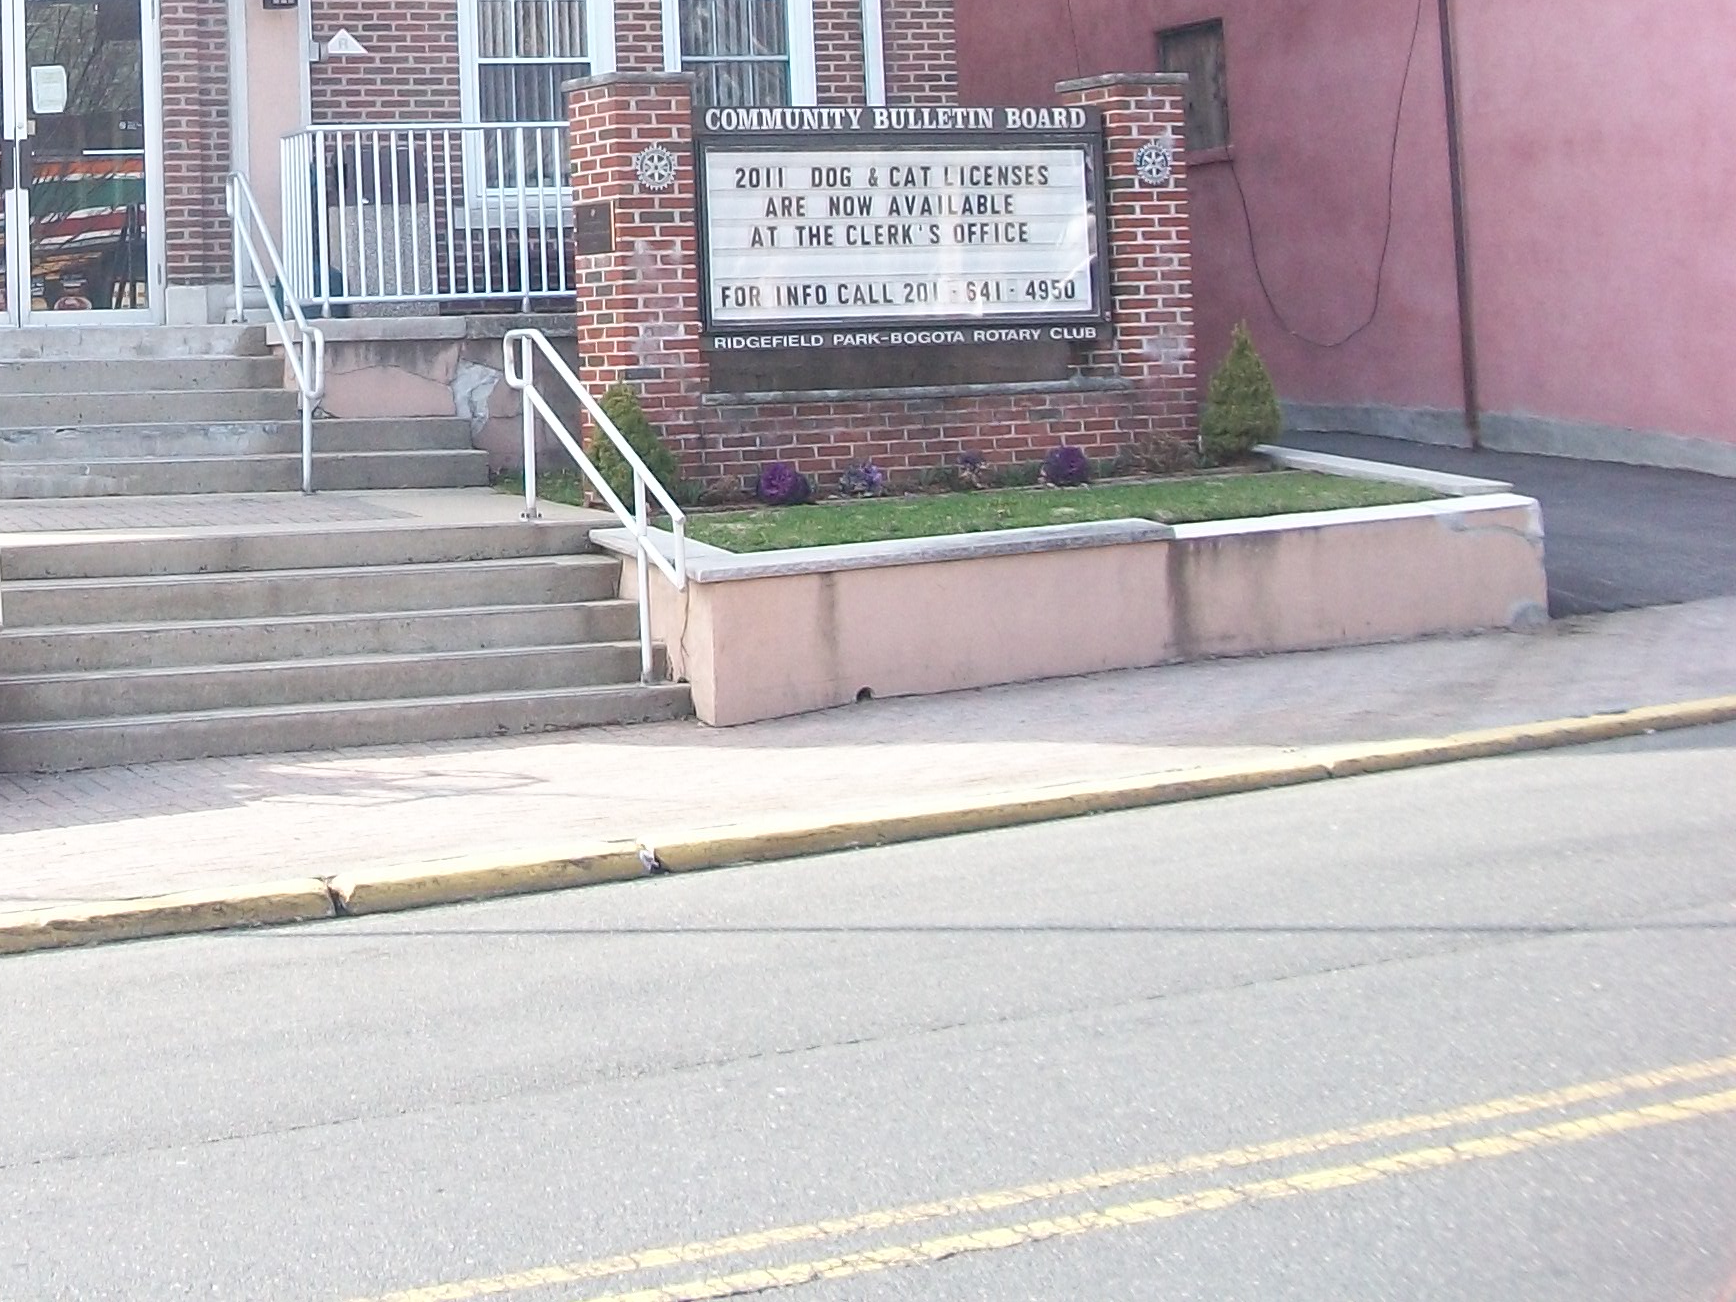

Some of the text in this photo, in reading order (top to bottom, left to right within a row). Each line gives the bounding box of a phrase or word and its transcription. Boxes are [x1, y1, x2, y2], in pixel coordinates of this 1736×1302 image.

[705, 107, 1087, 131] COMMUNITY BULLETIN BOARD
[735, 165, 1050, 189] 2011 DOG & CAT LICENSES
[765, 194, 1015, 218] ARE NOW AVAILABLE
[750, 222, 1030, 247] AT THE CLERK'S OFFICE
[720, 286, 762, 308] FOR
[776, 284, 828, 306] INFO
[837, 282, 895, 305] CALL
[714, 333, 824, 349] RIDGEFIELD
[974, 328, 1042, 343] ROTARY
[1050, 326, 1097, 340] CLUB
